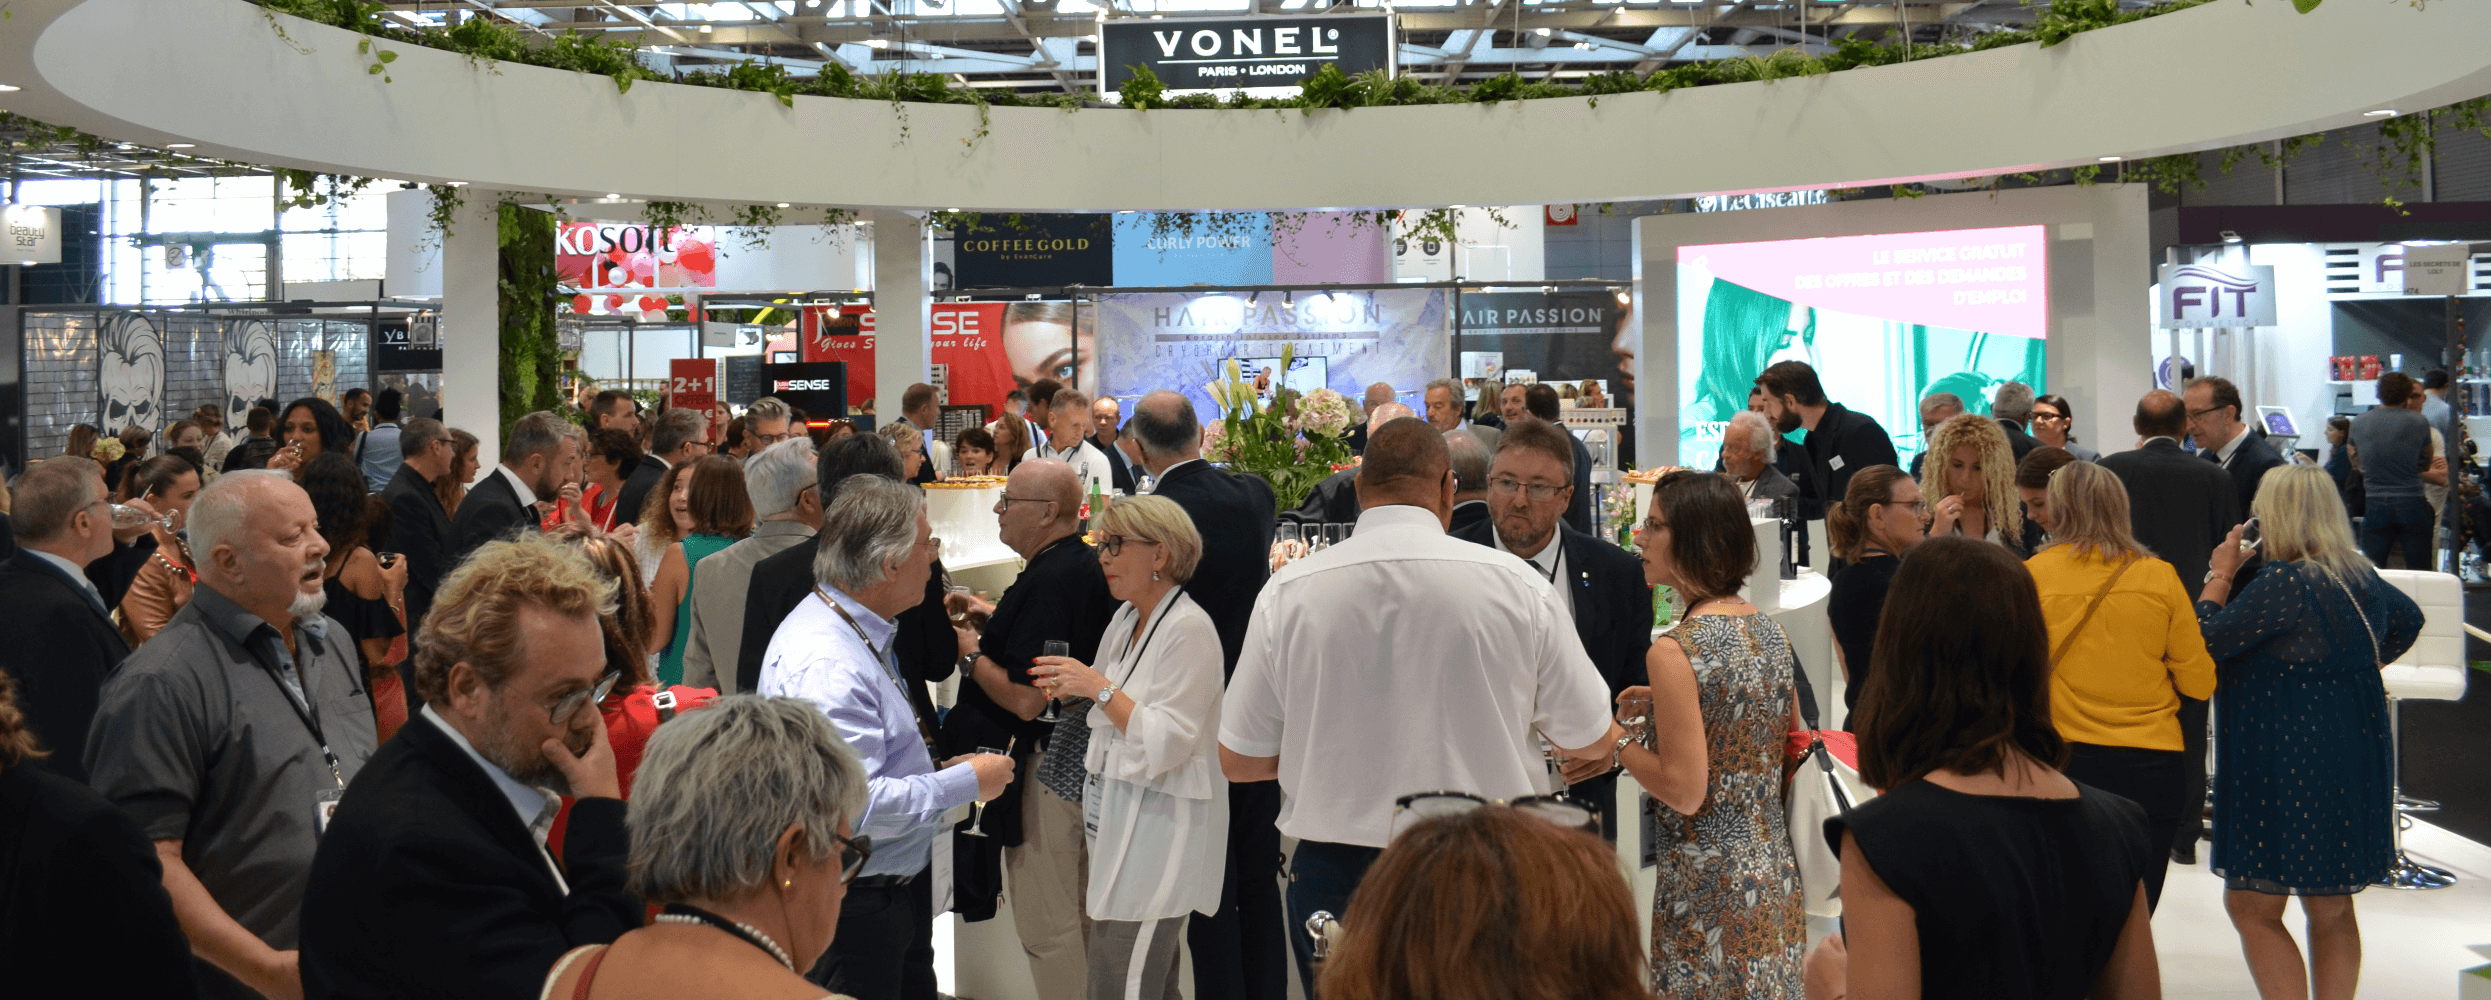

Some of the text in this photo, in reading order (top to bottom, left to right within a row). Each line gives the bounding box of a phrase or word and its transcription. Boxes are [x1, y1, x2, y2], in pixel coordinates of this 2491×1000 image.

[1198, 64, 1306, 77] PARIS LONDON
[1147, 235, 1251, 250] CURLY POWER
[1872, 242, 2028, 265] LE SERVICE GRATUIT
[1794, 265, 2028, 289] DES OFFRES ET DES DEMANDES
[1952, 288, 2028, 306] D'EMPLOI
[2173, 285, 2257, 320] FIT
[1154, 302, 1380, 327] HA PASSON
[1506, 308, 1601, 324] PASSION
[963, 336, 988, 351] life
[673, 376, 714, 393] 2+1
